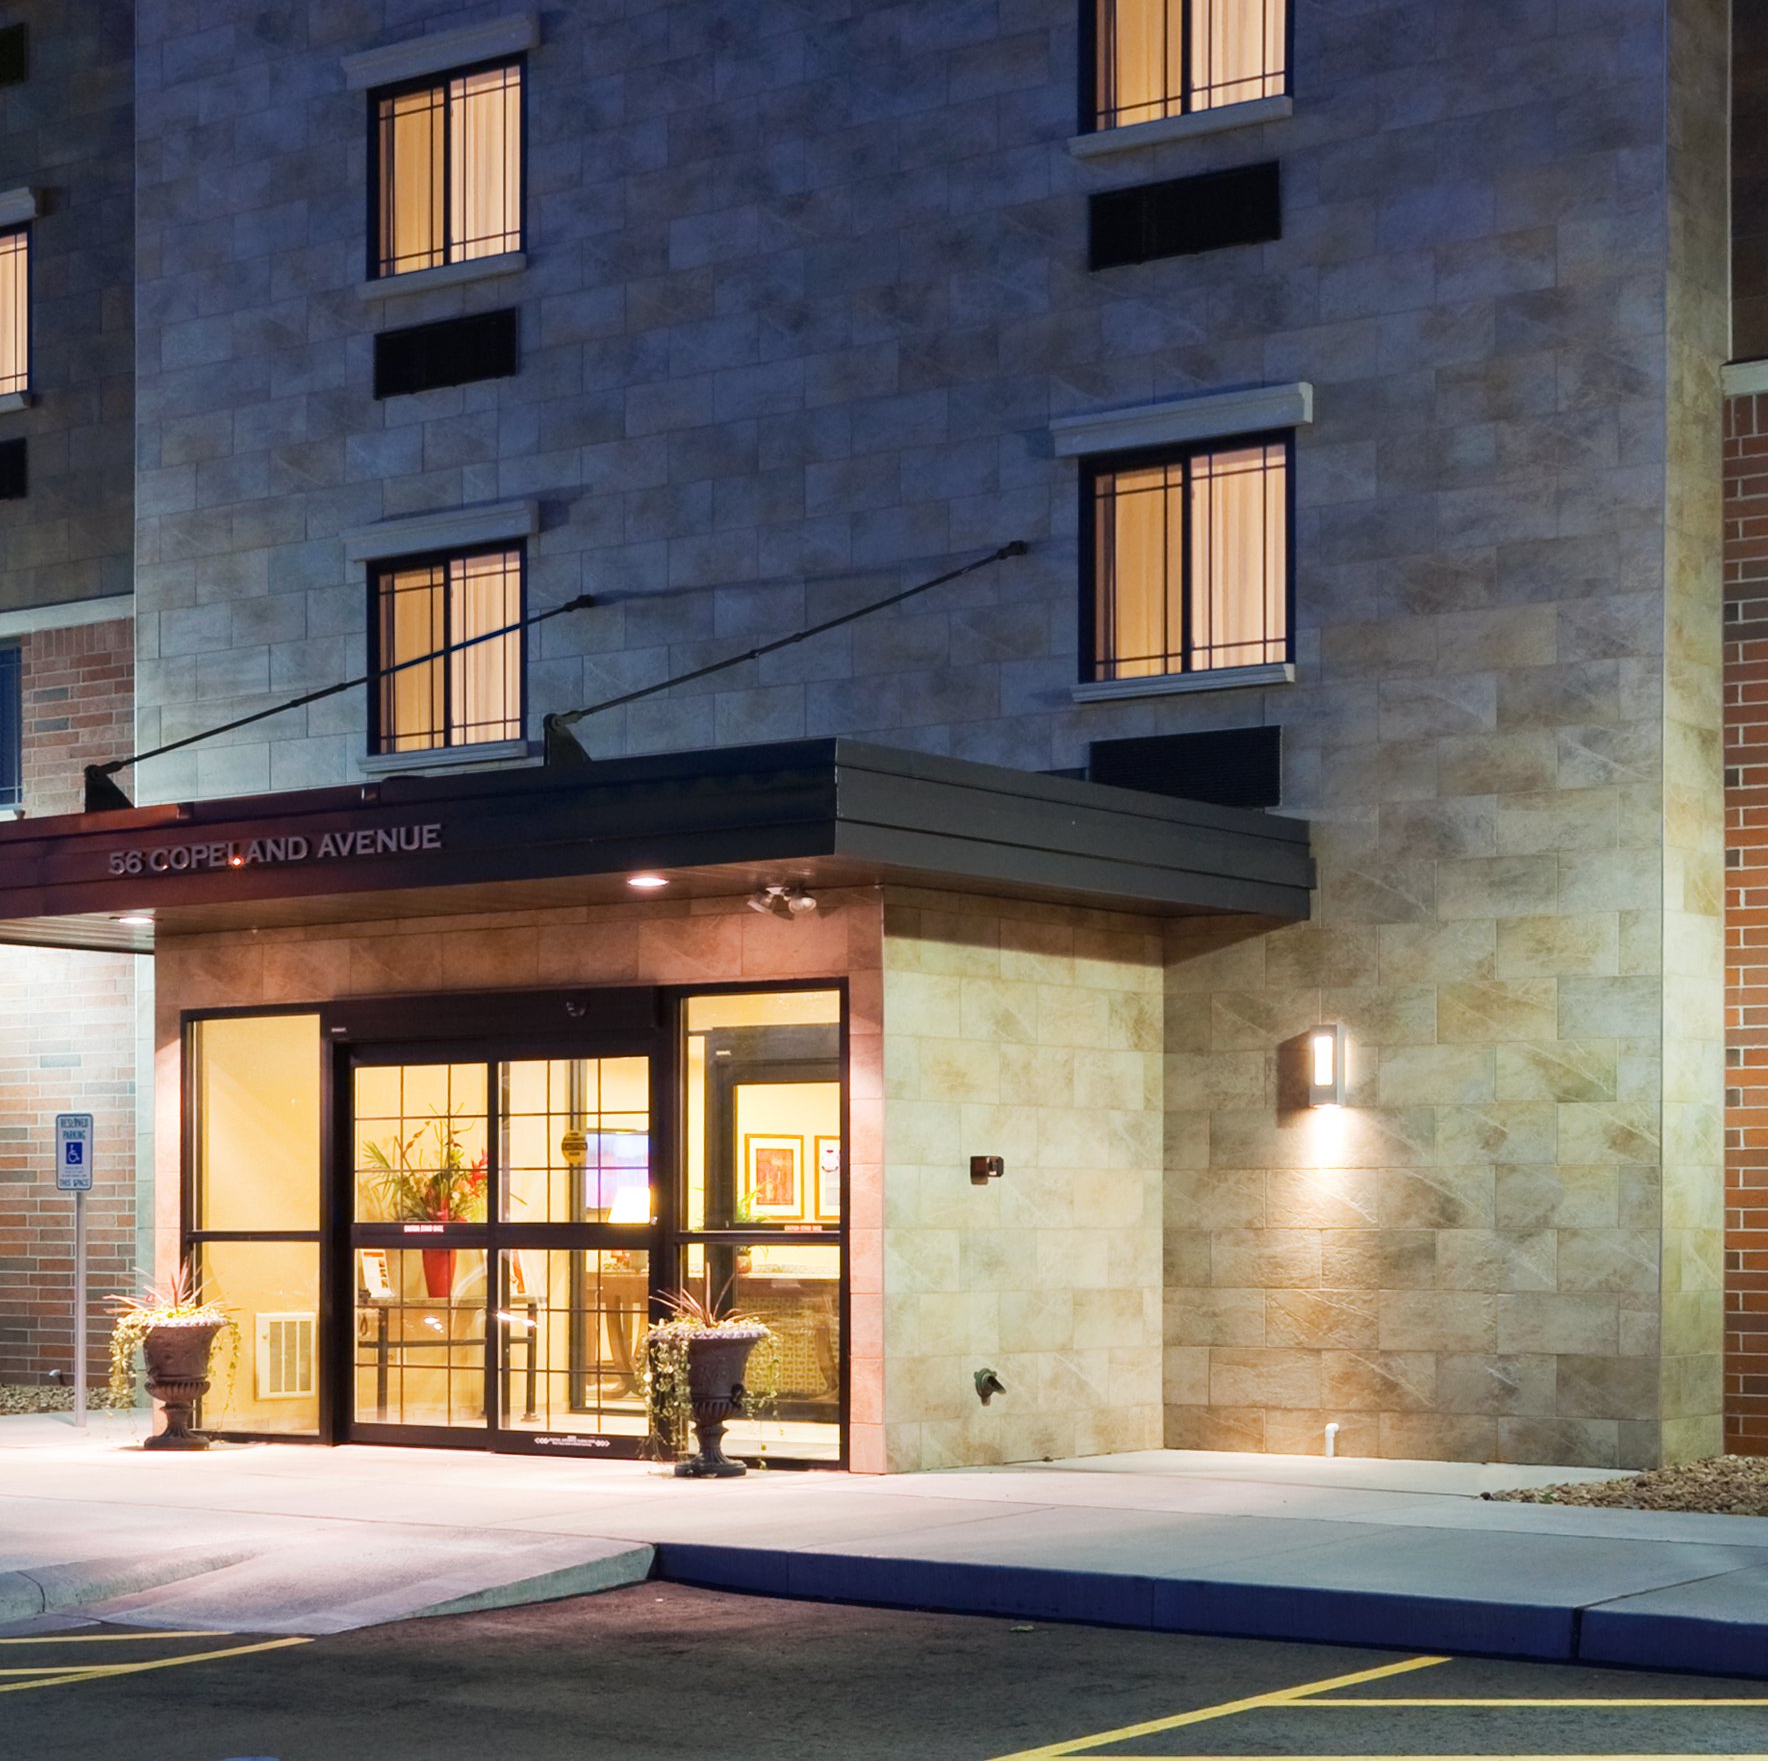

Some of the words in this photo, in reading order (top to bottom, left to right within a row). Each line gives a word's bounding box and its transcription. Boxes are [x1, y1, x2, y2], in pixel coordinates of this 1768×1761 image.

[108, 850, 142, 874] 56
[150, 837, 308, 871] COPELAND
[317, 823, 441, 858] AVENUE
